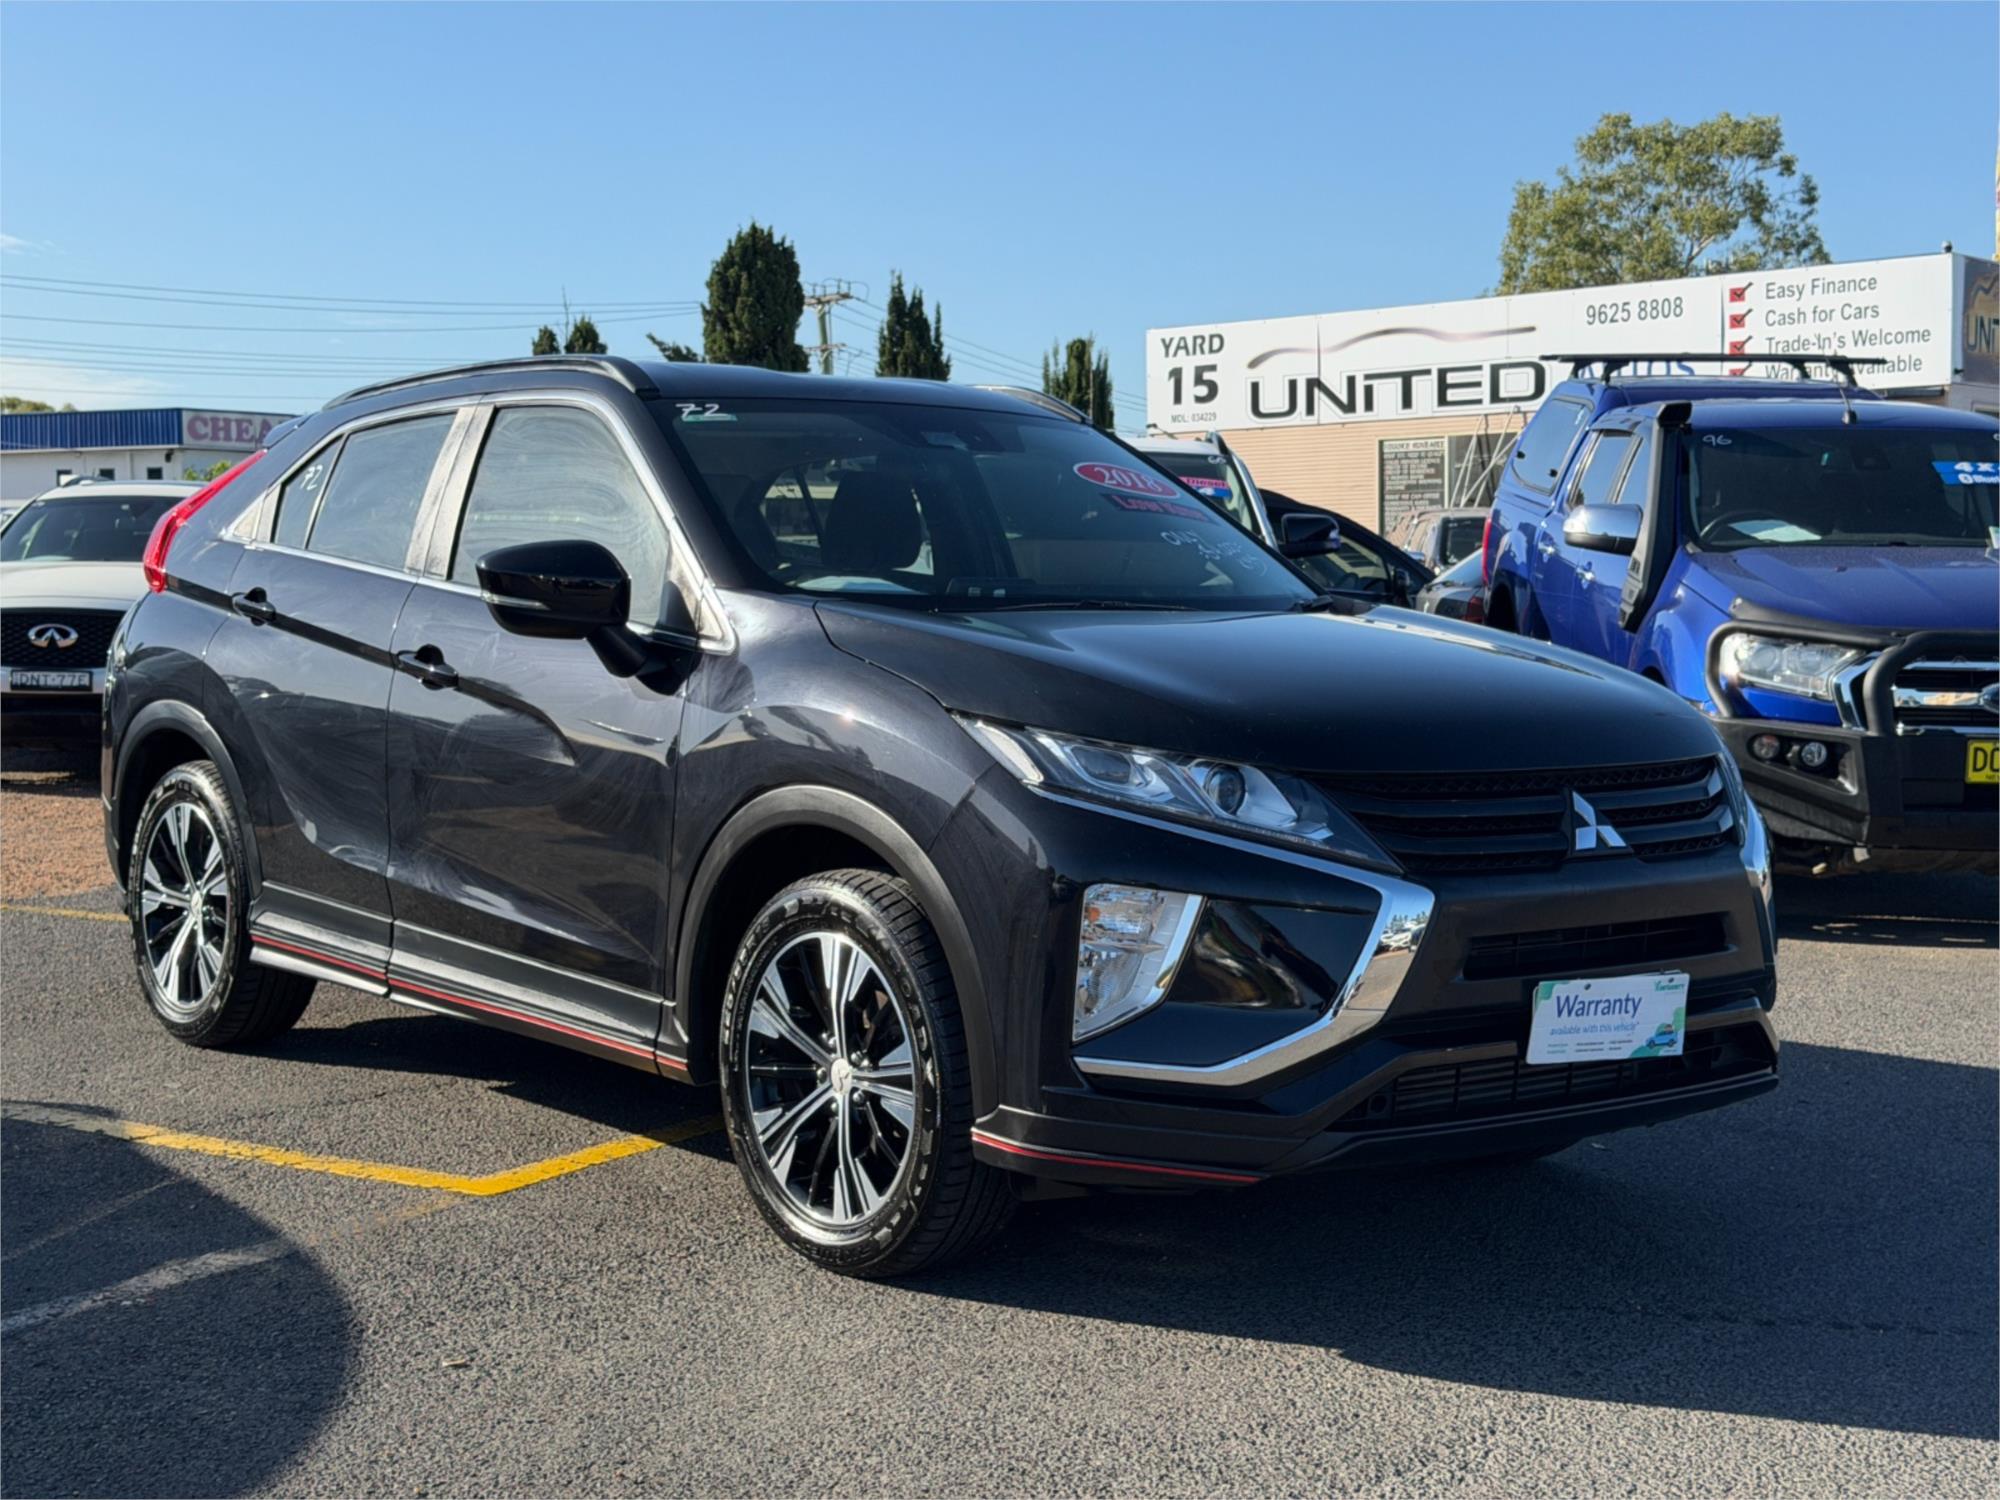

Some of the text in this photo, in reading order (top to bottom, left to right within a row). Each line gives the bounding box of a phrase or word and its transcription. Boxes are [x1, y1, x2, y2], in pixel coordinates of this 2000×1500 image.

[1765, 275, 1877, 304] Easy Finance
[1586, 297, 1683, 326] 9625 8808
[1765, 304, 1880, 328] Cash for Cars
[1160, 333, 1225, 358] YARD
[1852, 328, 1931, 347] Welcome
[1850, 355, 1923, 376] vailable
[1168, 363, 1219, 406] 15
[1250, 360, 1546, 420] UNITED
[186, 414, 284, 444] CHEA
[1702, 434, 1732, 446] 96
[1555, 993, 1643, 1019] Warranty
